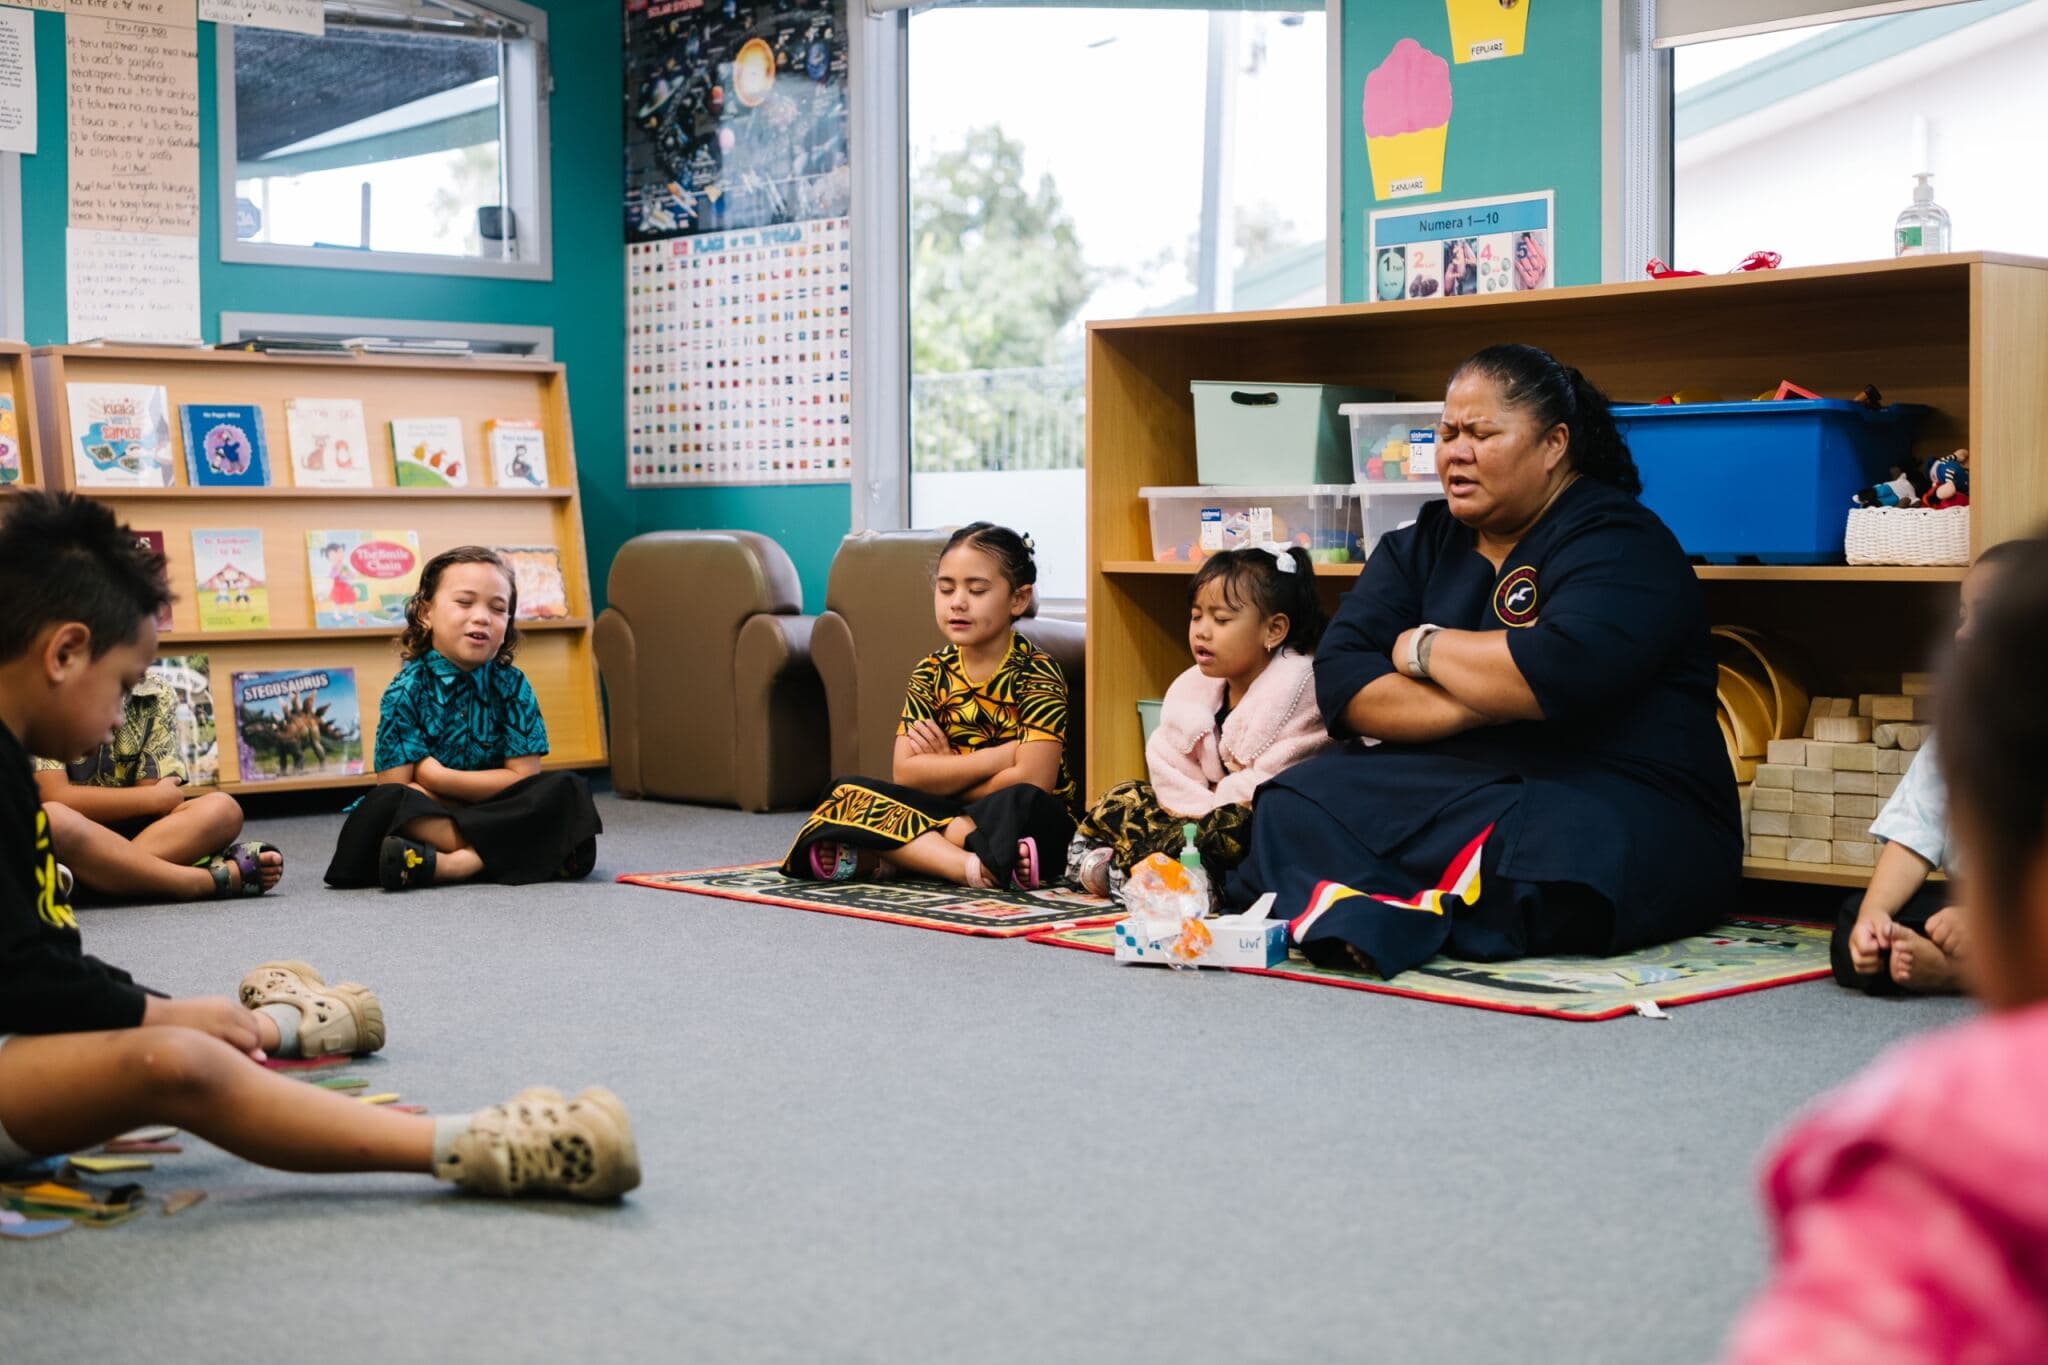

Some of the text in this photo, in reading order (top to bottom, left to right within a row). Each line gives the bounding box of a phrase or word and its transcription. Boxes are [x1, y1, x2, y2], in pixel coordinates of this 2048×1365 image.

[1471, 42, 1503, 56] FEPUARI
[1391, 181, 1424, 193] IANUARI
[1419, 218, 1464, 233] Numera
[1480, 243, 1493, 261] 4
[1516, 241, 1528, 259] 5
[1383, 256, 1391, 272] 1
[1413, 251, 1425, 269] 2
[243, 673, 329, 701] STEGOSAURUS
